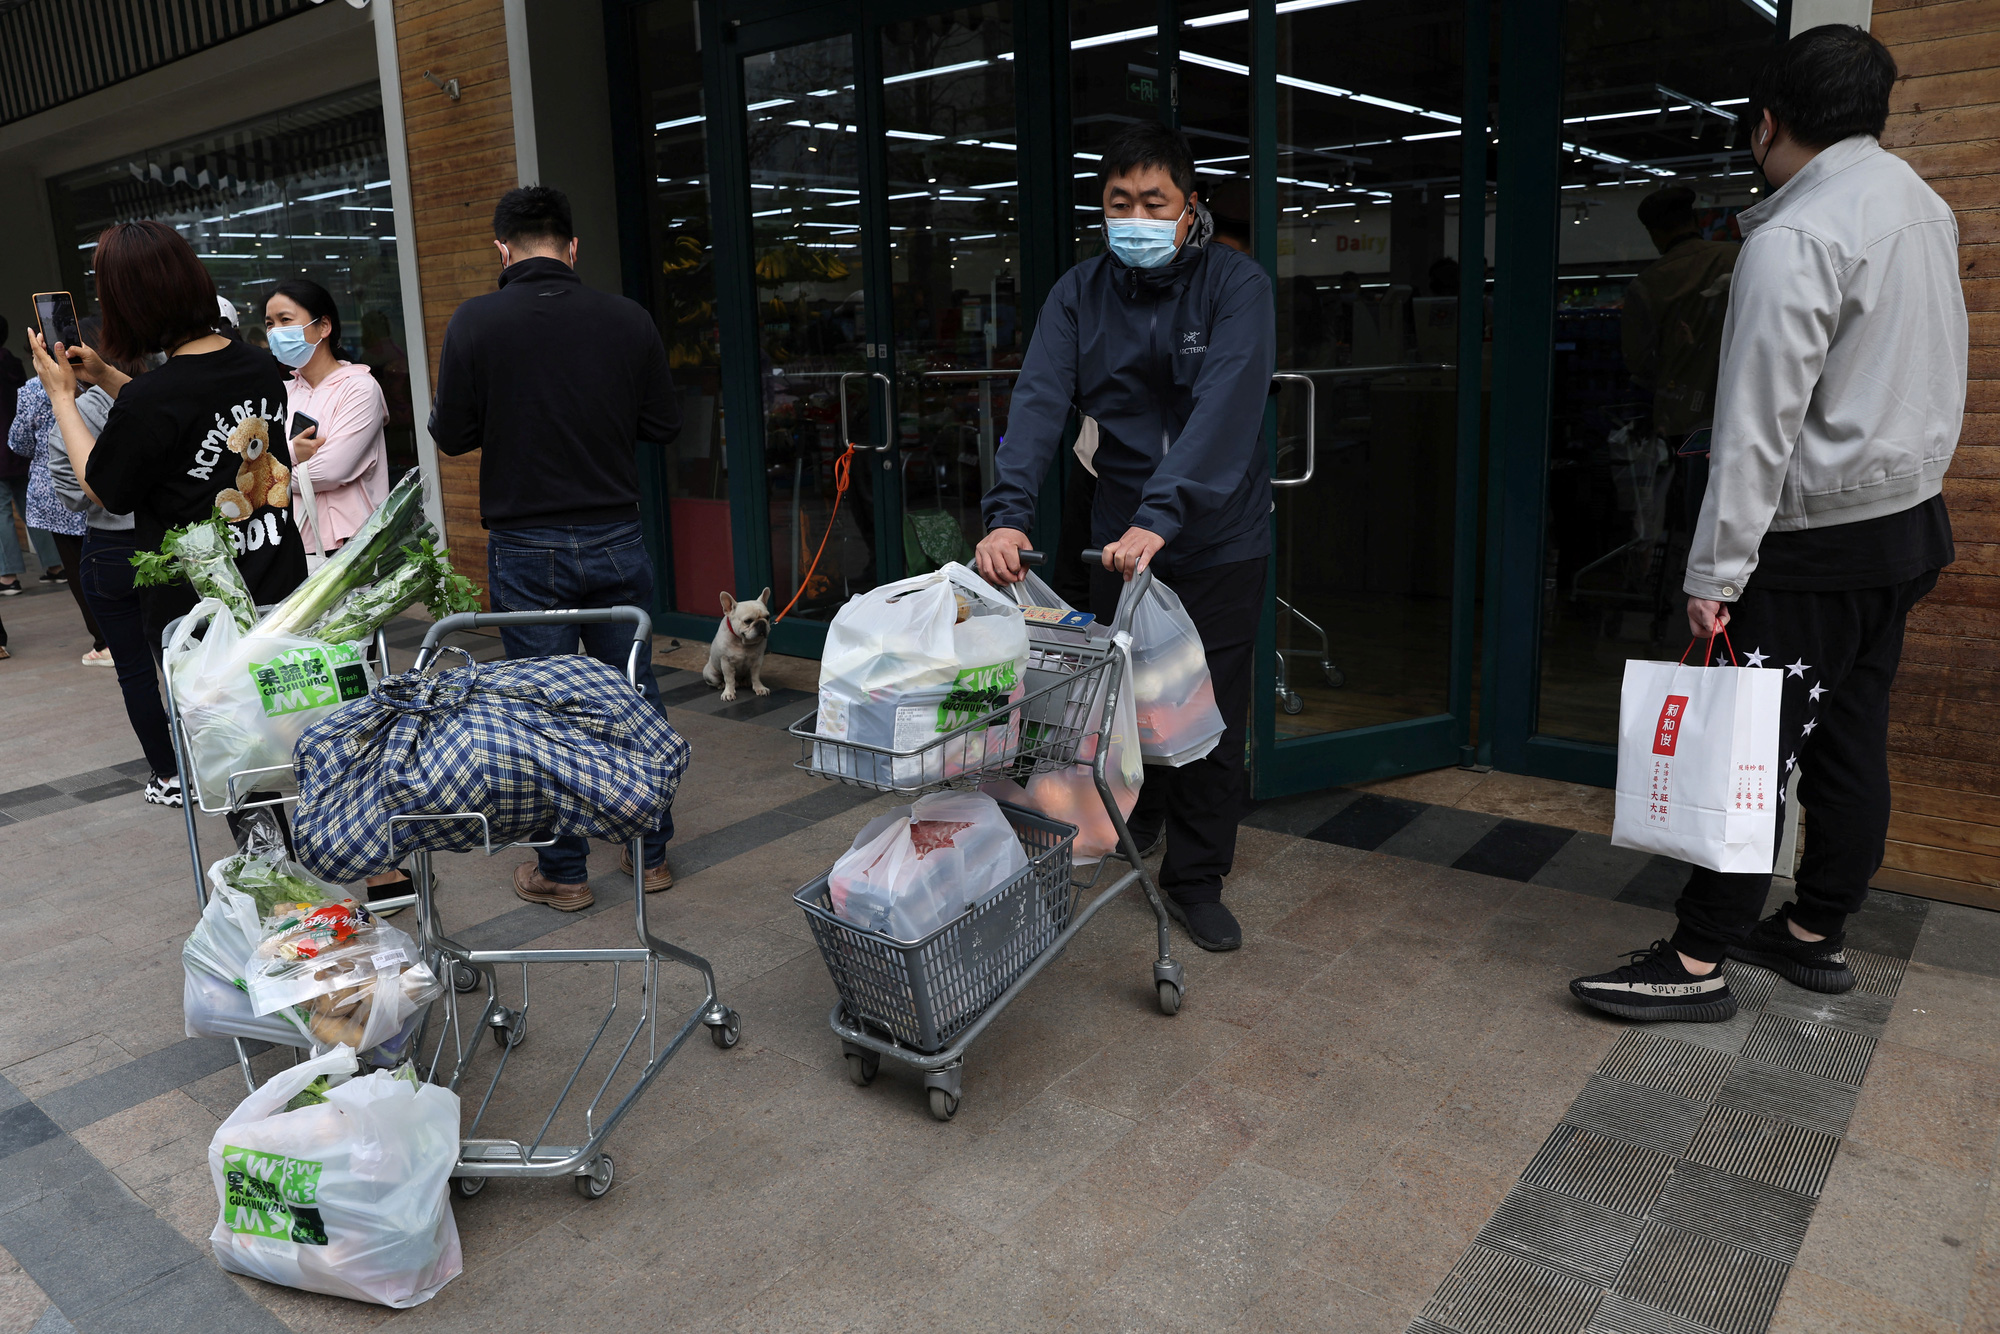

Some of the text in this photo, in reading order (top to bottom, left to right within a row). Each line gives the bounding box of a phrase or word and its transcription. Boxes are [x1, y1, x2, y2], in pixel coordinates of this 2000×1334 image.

[1336, 233, 1387, 254] Dairy
[187, 413, 237, 480] ACMÉ
[231, 400, 257, 425] DE
[257, 658, 324, 688] 果蔬好
[338, 673, 358, 683] Fresh
[263, 675, 329, 697] GUOSHUHAO
[1651, 985, 1702, 994] SPLY-350
